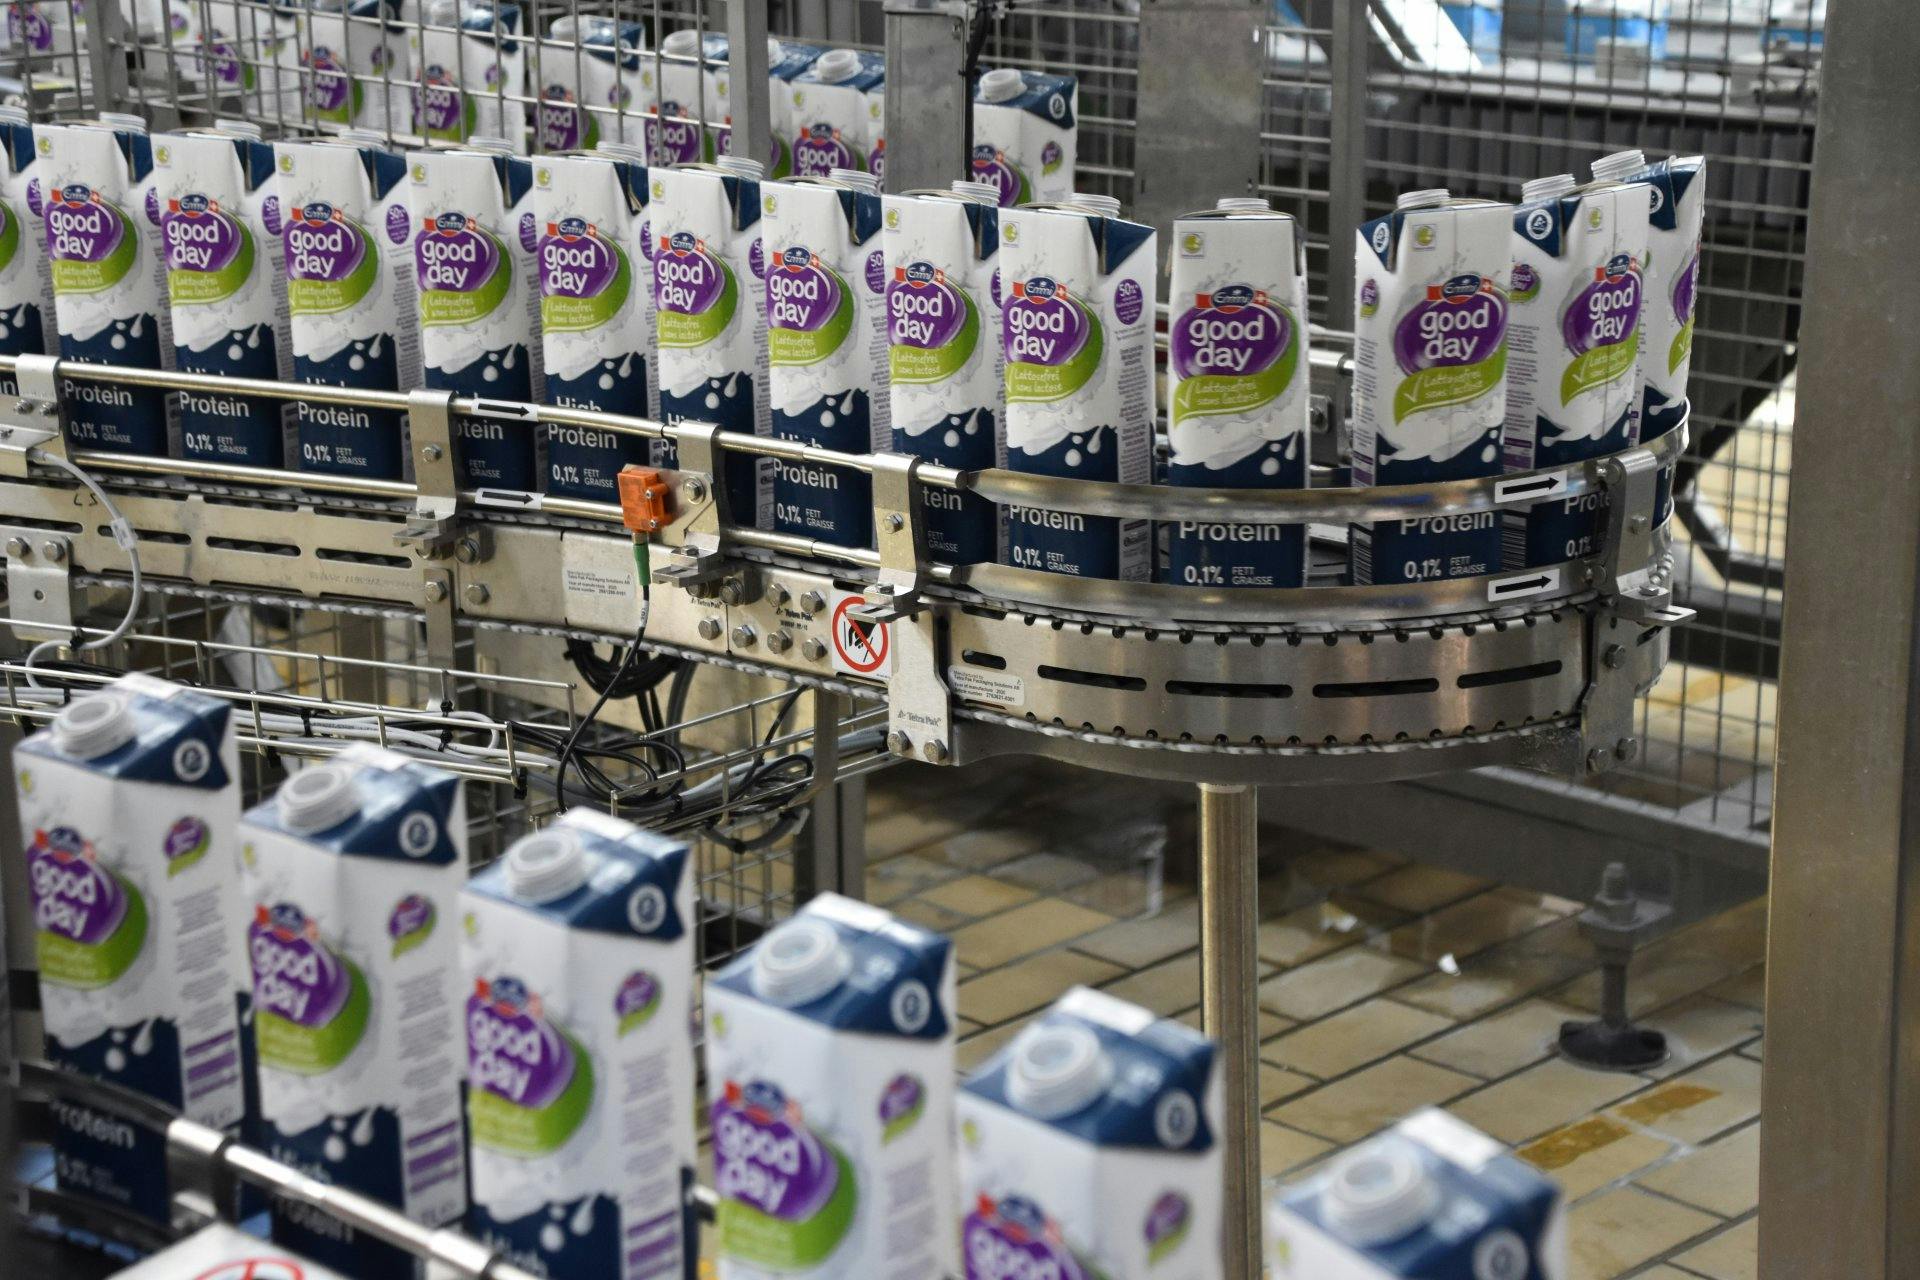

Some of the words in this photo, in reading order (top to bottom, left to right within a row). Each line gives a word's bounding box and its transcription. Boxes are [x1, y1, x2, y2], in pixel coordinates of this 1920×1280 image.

[798, 146, 839, 168] good
[50, 210, 100, 235] good
[167, 219, 219, 245] good
[560, 222, 583, 234] Emmi
[56, 231, 94, 259] day
[289, 228, 342, 254] good
[421, 238, 476, 265] good
[173, 240, 212, 269] day
[295, 250, 335, 278] day
[544, 244, 595, 270] good
[784, 251, 807, 264] Emmi
[426, 259, 469, 289] day
[549, 266, 588, 295] day
[657, 258, 703, 285] good
[907, 267, 932, 279] Emmi
[661, 280, 696, 311] day
[770, 275, 818, 301] good
[1026, 282, 1054, 296] Emmi
[1588, 280, 1634, 320] good
[774, 297, 811, 327] day
[891, 290, 942, 318] good
[896, 313, 935, 345] day
[1009, 306, 1065, 334] good
[1189, 314, 1265, 346] good
[1419, 301, 1489, 339] good
[1591, 312, 1627, 340] day
[1013, 329, 1056, 361] day
[1194, 341, 1253, 372] day
[1424, 333, 1478, 361] day
[64, 380, 133, 406] Protein
[179, 390, 250, 417] Protein
[298, 401, 370, 428] Protein
[217, 435, 233, 445] FETT
[458, 419, 504, 440] tein
[548, 423, 618, 449] Protein
[186, 432, 214, 453] 0,1%
[218, 444, 249, 455] GRAISSE
[303, 443, 331, 463] 0,1%
[335, 447, 352, 456] FETT
[336, 456, 368, 466] GRAISSE
[583, 468, 600, 477] FETT
[773, 458, 838, 489] Protein
[552, 464, 579, 485] 0,1%
[584, 477, 614, 489] GRAISSE
[922, 486, 962, 511] tein
[777, 502, 802, 524] 0,1%
[805, 508, 821, 518] FETT
[806, 517, 835, 530] GRAISSE
[1010, 504, 1084, 531] Protein
[1400, 511, 1494, 535] Protein
[1179, 521, 1280, 541] Protein
[1014, 545, 1042, 567] 0,1%
[1046, 551, 1064, 562] FETT
[1047, 561, 1080, 574] GRAISSE
[1450, 555, 1471, 566] FETT
[1184, 565, 1224, 586] 0,1%
[1231, 566, 1255, 576] FETT
[1231, 576, 1274, 585] GRAISSE
[1404, 558, 1442, 582] 0,1%
[1449, 563, 1486, 576] GRAISSE
